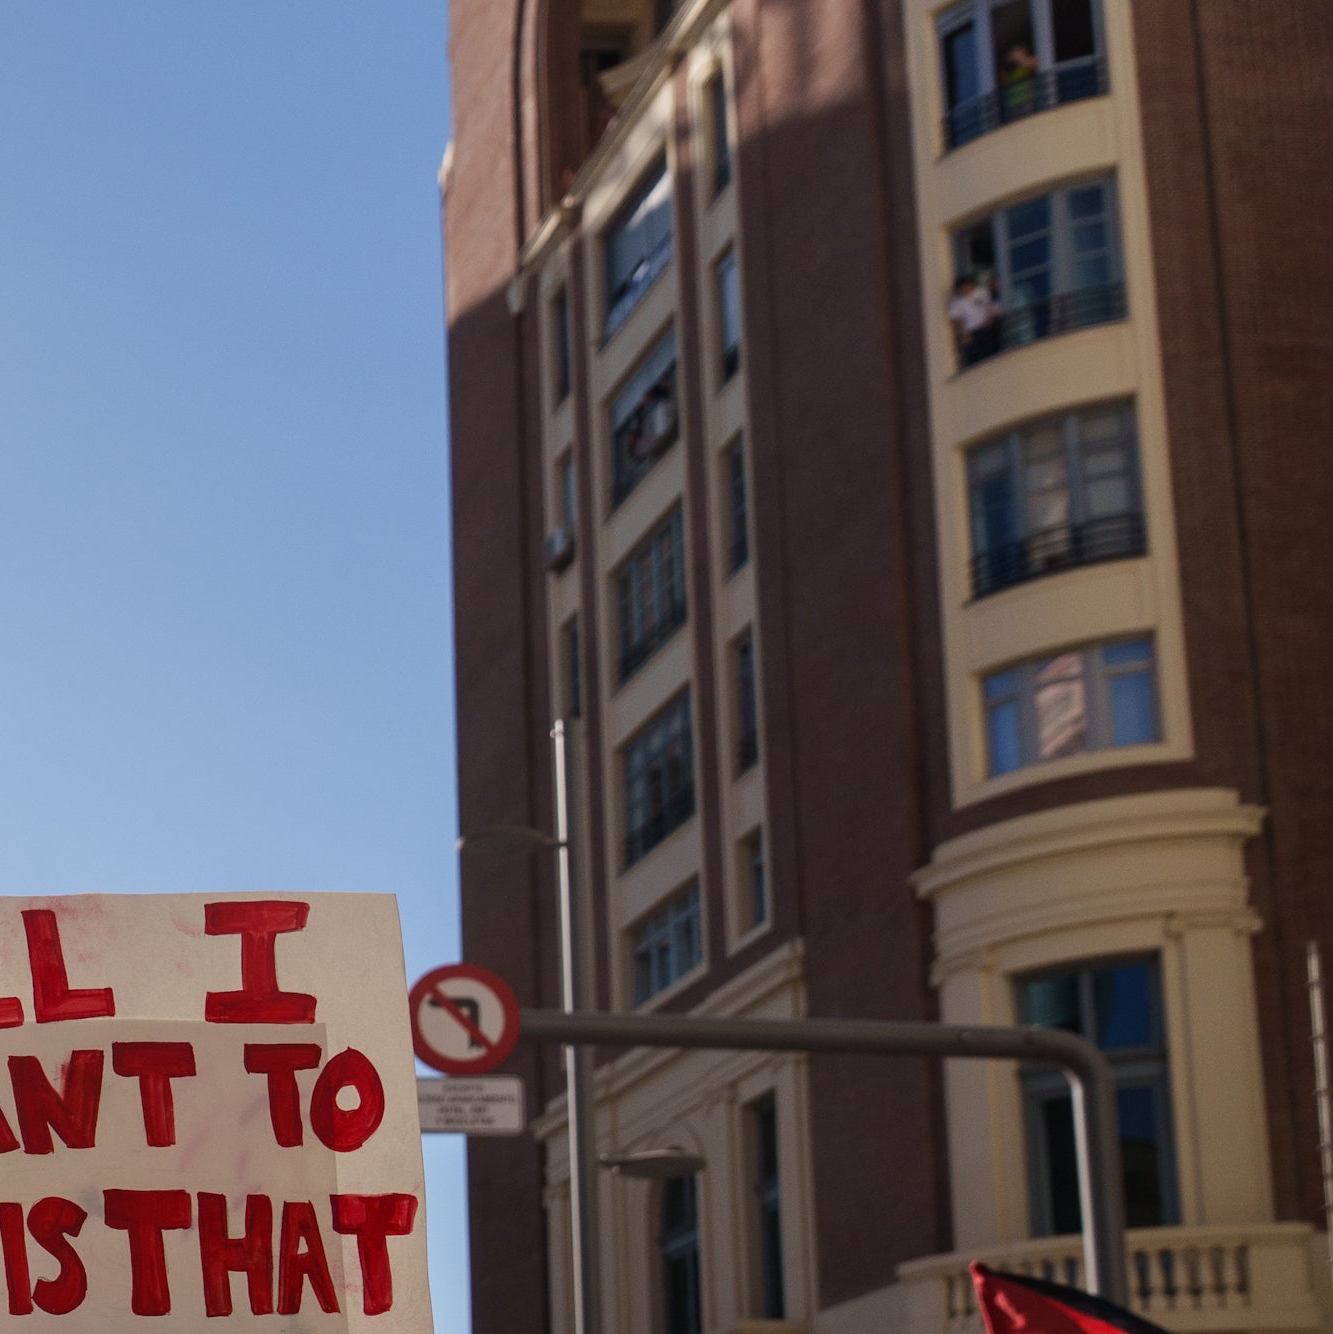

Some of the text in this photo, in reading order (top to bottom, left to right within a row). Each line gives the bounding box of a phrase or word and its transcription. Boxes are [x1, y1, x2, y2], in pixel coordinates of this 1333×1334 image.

[204, 900, 317, 1026] I
[244, 1042, 387, 1154] TO
[0, 1195, 89, 1318] IS
[103, 1188, 419, 1318] THAT
